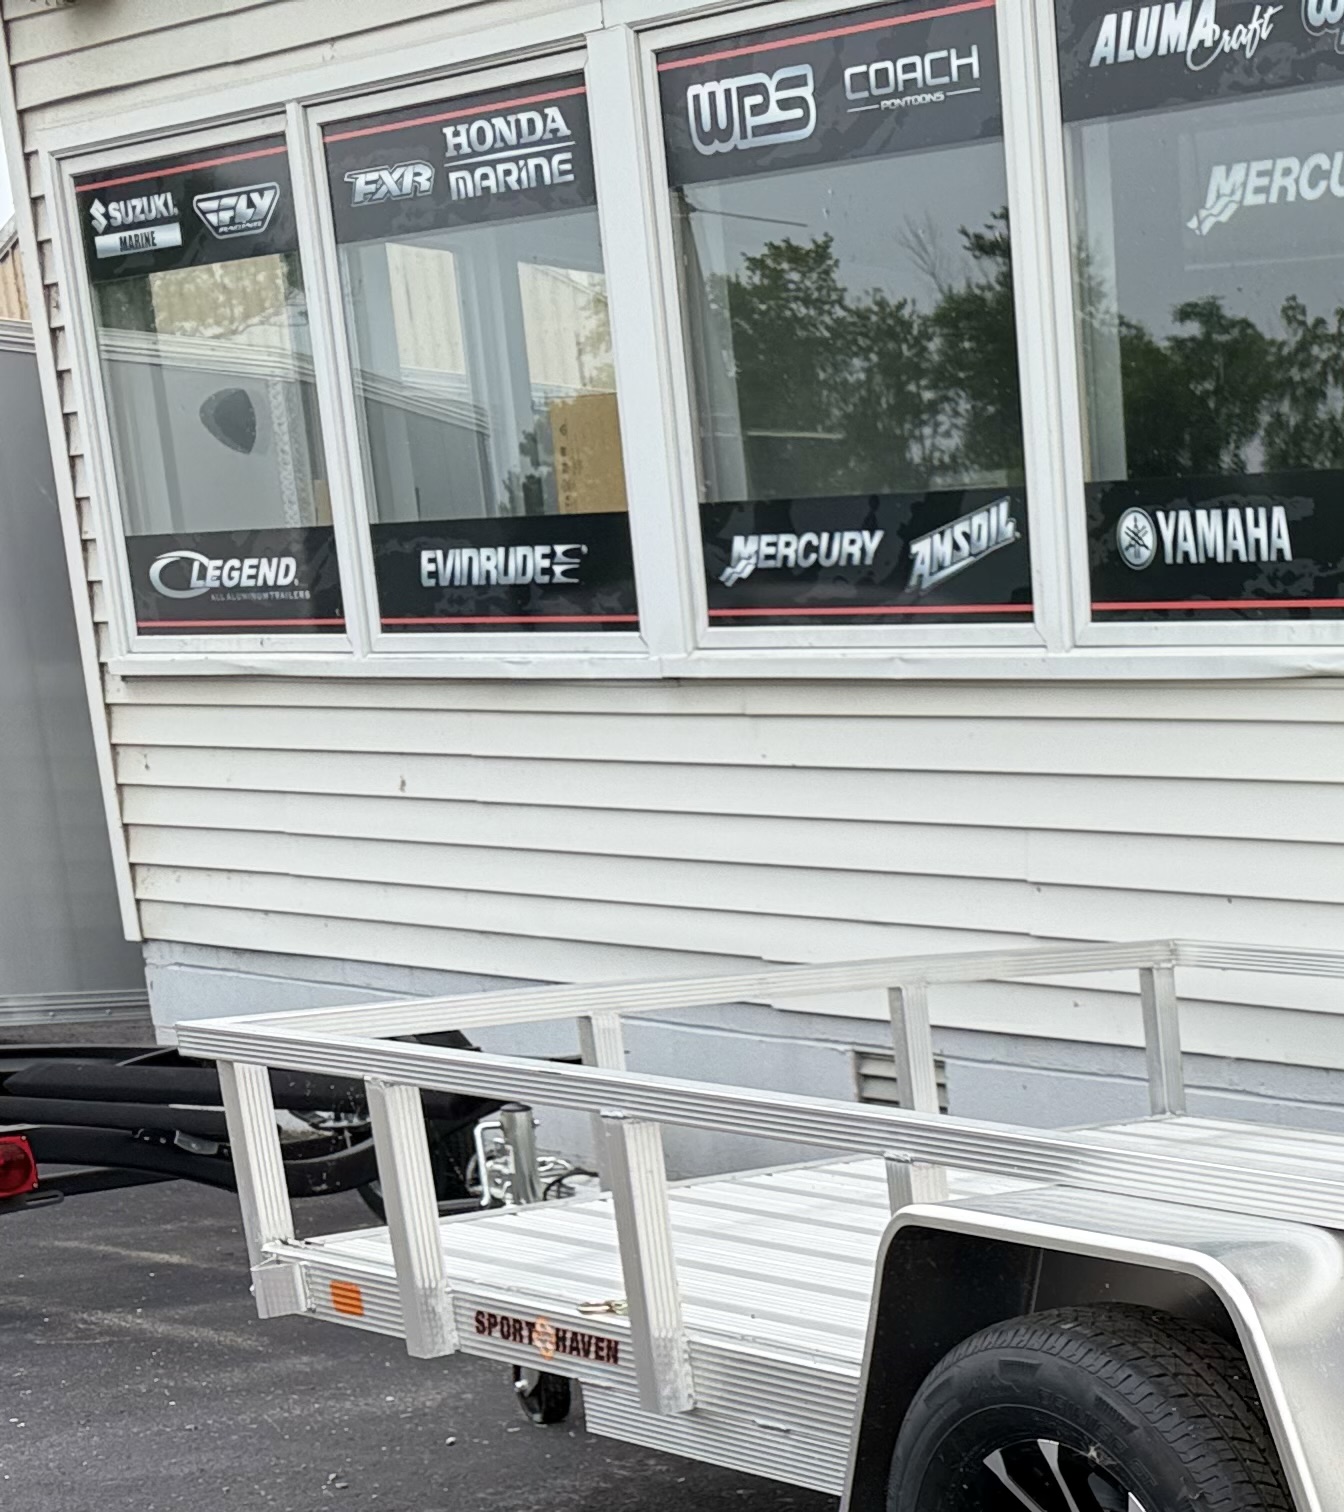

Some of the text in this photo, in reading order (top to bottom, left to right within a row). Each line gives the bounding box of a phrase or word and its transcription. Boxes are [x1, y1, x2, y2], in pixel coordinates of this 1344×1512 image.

[844, 44, 979, 101] COACH
[687, 63, 816, 155] WPS
[880, 91, 945, 111] PONTOONS
[442, 106, 571, 157] HONDA
[346, 161, 434, 206] FXR
[448, 152, 575, 200] MARINE
[107, 192, 178, 227] SUZUKI
[197, 188, 276, 227] FLY
[118, 230, 157, 253] MARINE
[726, 530, 884, 579] MERCURY
[909, 498, 1017, 594] AMSOIL
[1155, 505, 1293, 565] YAMAHA
[190, 556, 297, 588] LEGEND
[420, 545, 552, 587] EVINRUDE
[474, 1310, 620, 1364] SPORT HAVEN
